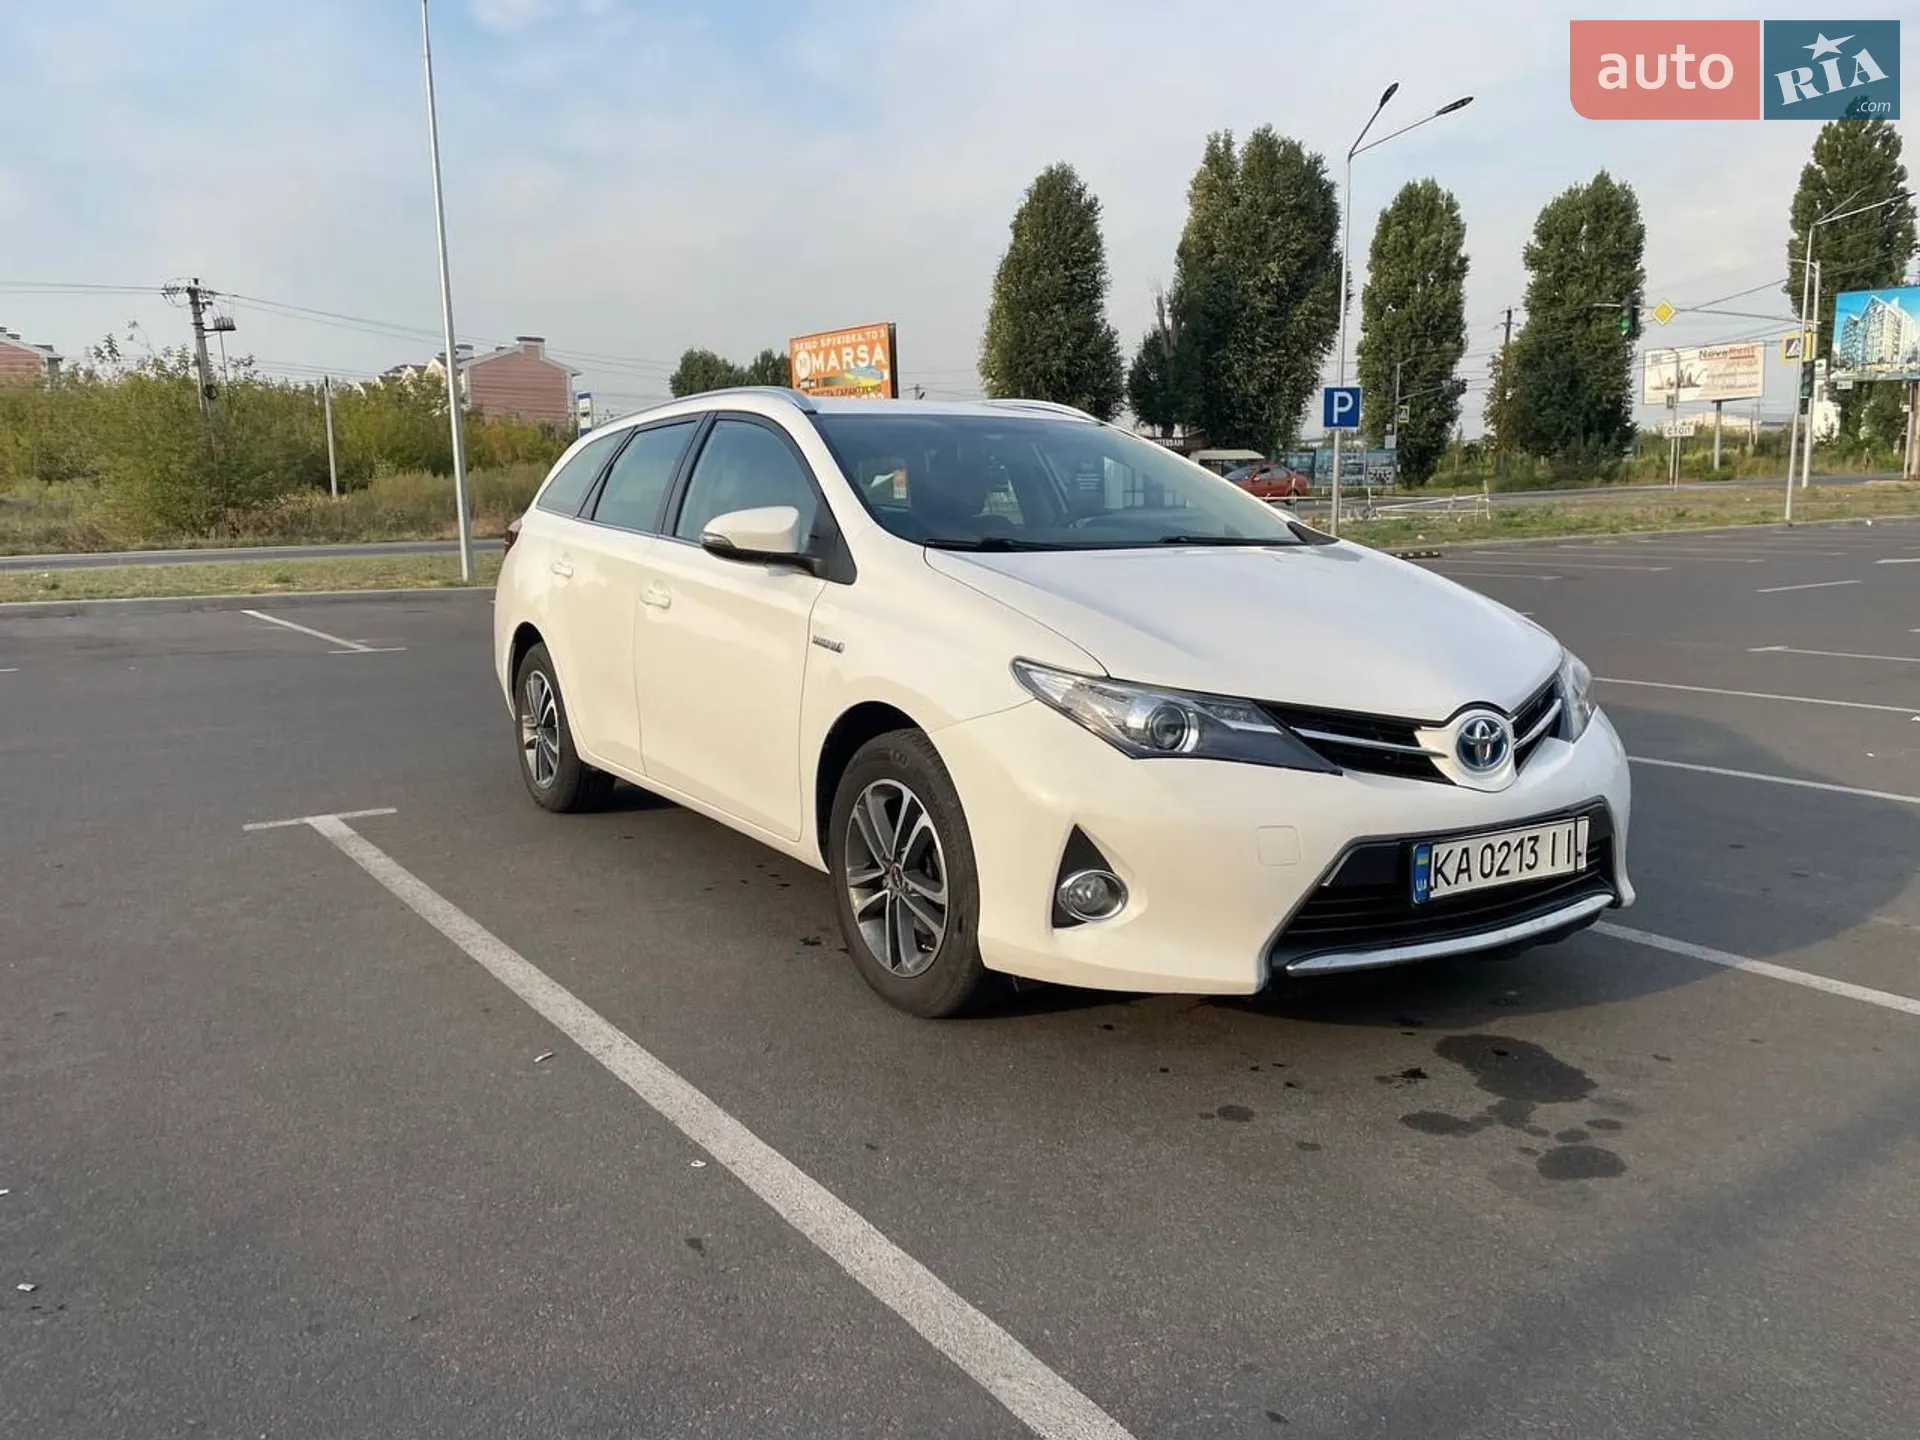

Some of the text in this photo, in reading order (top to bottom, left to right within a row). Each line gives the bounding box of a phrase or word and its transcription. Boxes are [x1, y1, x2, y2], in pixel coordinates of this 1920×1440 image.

[1333, 391, 1353, 424] P
[1433, 847, 1472, 889] KA
[1479, 835, 1540, 879] 0213
